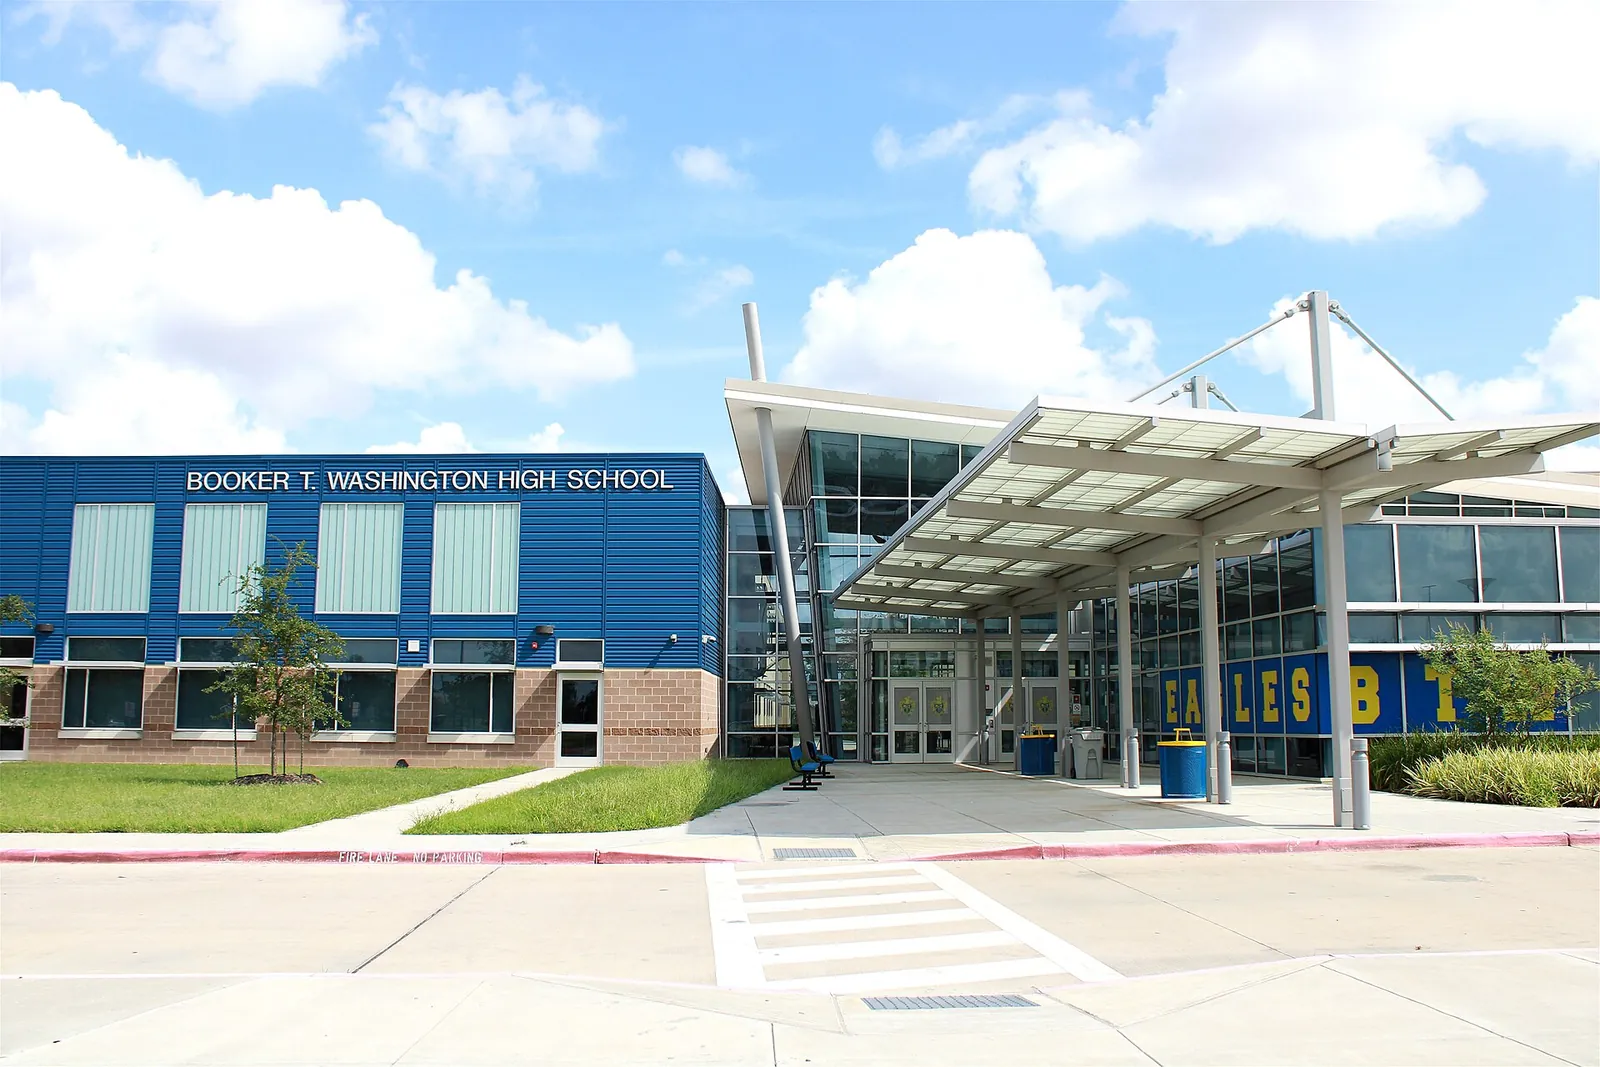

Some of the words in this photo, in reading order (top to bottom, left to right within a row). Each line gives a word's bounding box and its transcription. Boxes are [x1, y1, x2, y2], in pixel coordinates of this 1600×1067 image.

[186, 471, 289, 491] BOOKER
[299, 471, 316, 490] T.
[327, 470, 488, 490] WASHINGTON
[499, 470, 556, 489] HIGH
[567, 469, 675, 489] SCHOOL
[1165, 667, 1311, 724] EALES
[338, 851, 364, 863] FIRE
[368, 851, 399, 864] LANE
[412, 851, 428, 864] NO
[432, 851, 482, 864] PARKING
